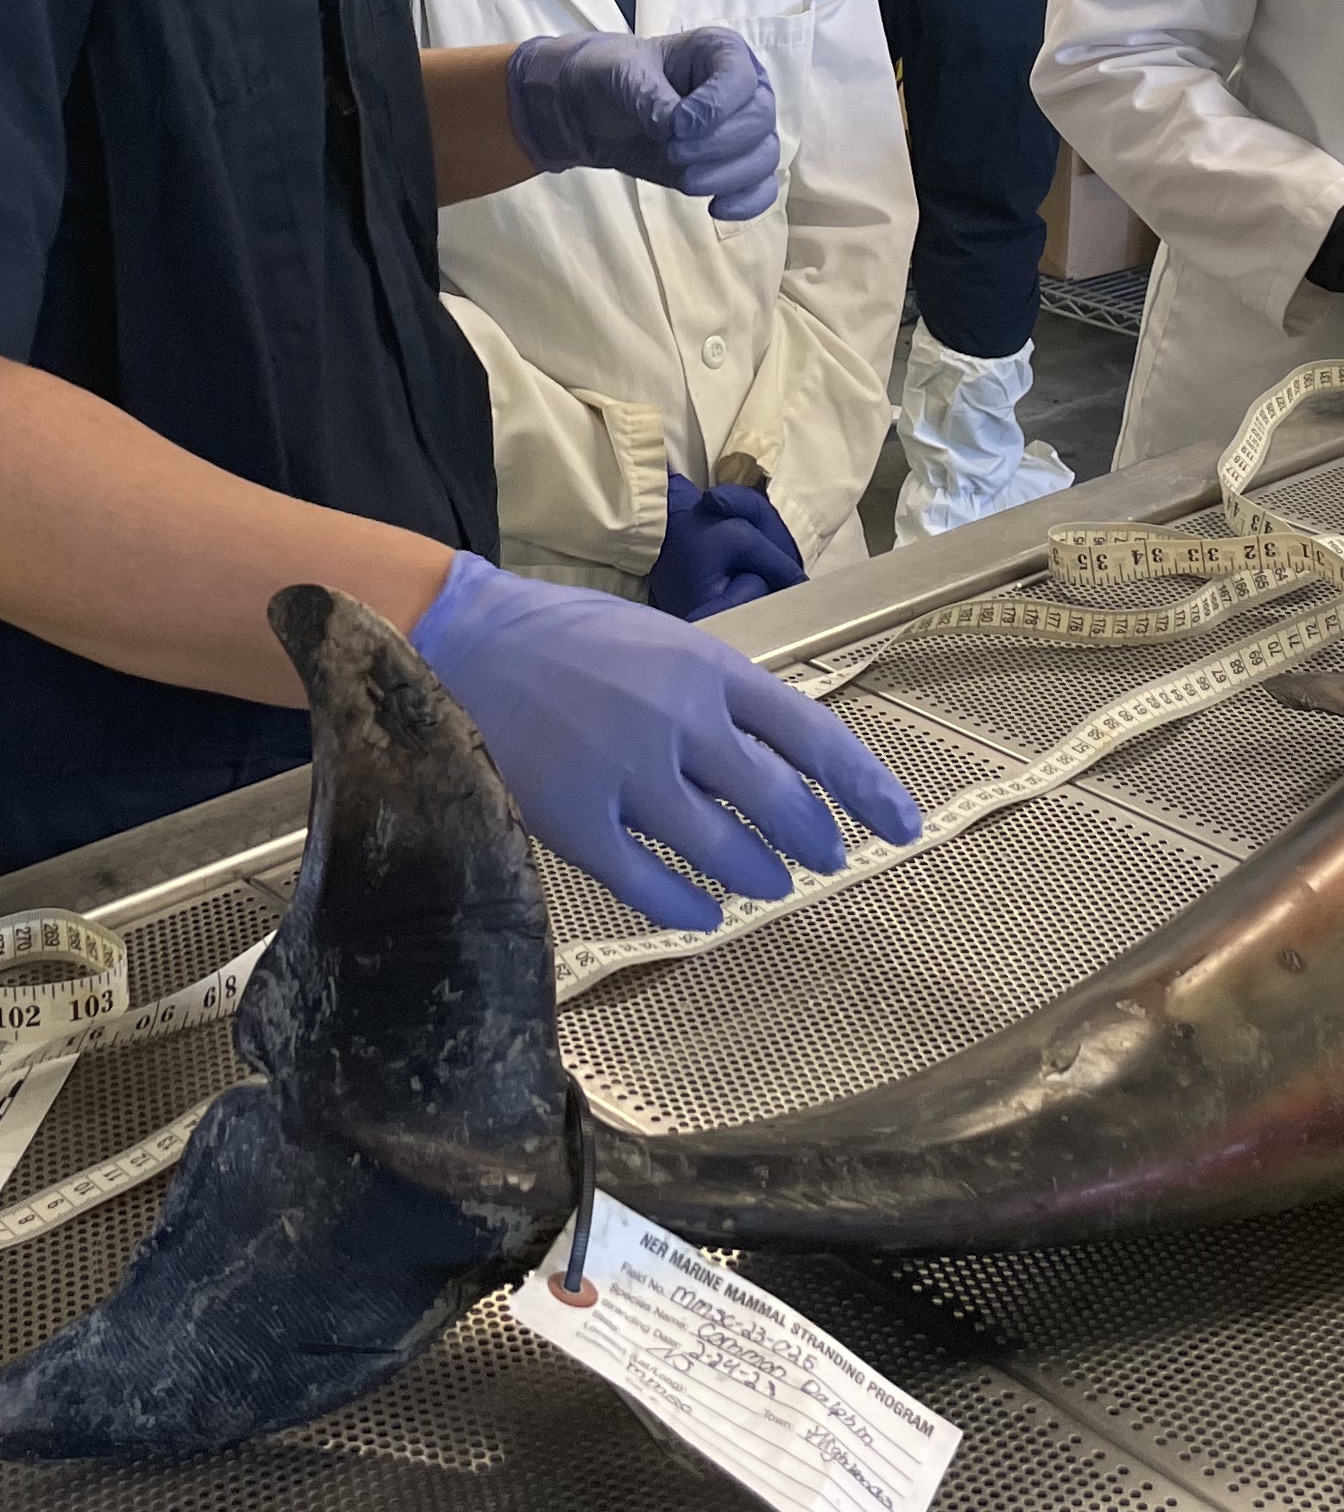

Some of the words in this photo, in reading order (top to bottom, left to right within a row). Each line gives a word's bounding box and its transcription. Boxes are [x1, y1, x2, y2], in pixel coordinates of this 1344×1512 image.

[1025, 608, 1038, 626] 178
[1047, 612, 1061, 629] 177
[1115, 617, 1128, 634] 174
[1135, 616, 1150, 634] 173
[1157, 614, 1170, 633] 172
[1175, 609, 1186, 627] 171
[1234, 576, 1250, 598] 166
[1305, 621, 1319, 639] 72
[1324, 614, 1338, 632] 73
[1267, 640, 1282, 658] 70
[1288, 632, 1302, 649] 71
[1210, 668, 1227, 684] 67
[1071, 741, 1091, 755] 57
[16, 926, 32, 952] 270
[44, 922, 60, 947] 269
[68, 989, 115, 1022] 103
[18, 1214, 36, 1226] 8
[47, 1198, 65, 1211] 9
[73, 1180, 96, 1197] 10
[102, 1167, 124, 1183] 11
[129, 1152, 152, 1169] 12
[639, 1231, 669, 1259] NER
[668, 1249, 724, 1292] MARINE
[723, 1283, 787, 1329] MAMMAL
[790, 1321, 866, 1386] STRANDING
[867, 1380, 935, 1439] PROGRAM
[697, 1322, 787, 1378] Common
[801, 1379, 874, 1447] Dolphin
